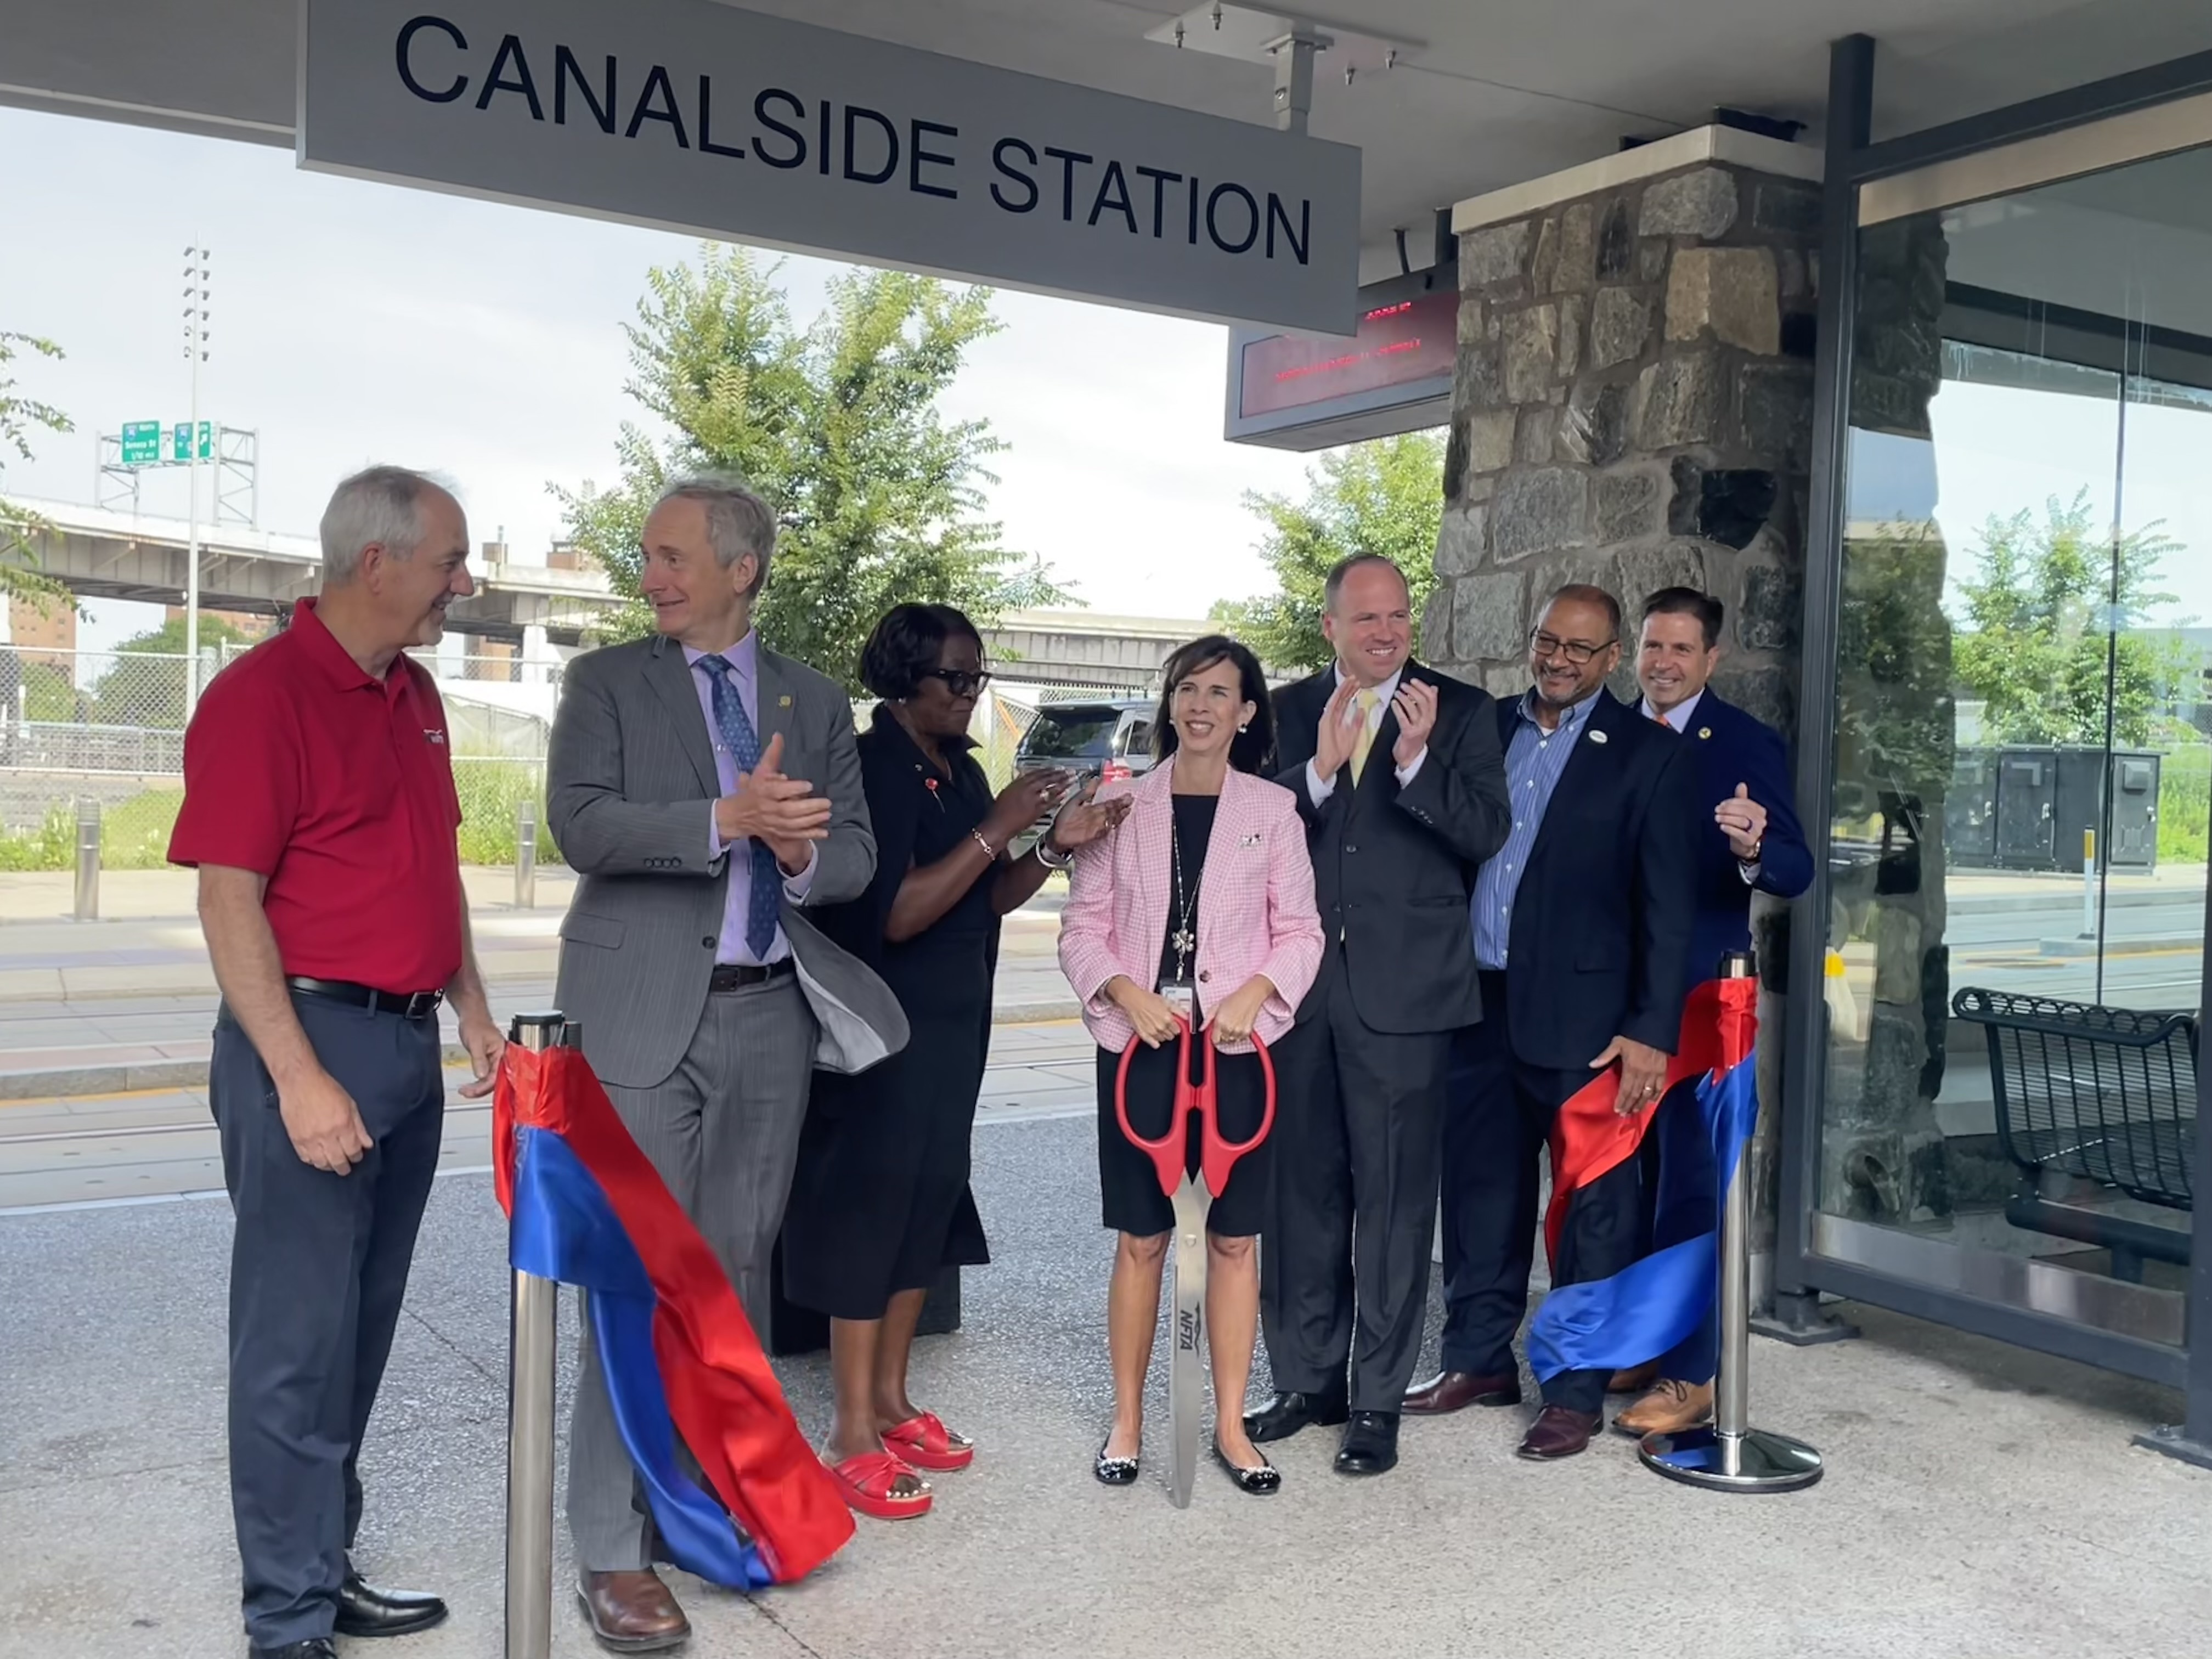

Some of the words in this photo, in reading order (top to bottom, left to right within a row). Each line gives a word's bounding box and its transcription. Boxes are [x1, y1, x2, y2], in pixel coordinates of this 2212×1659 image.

[395, 15, 959, 201] CANALSIDE
[989, 137, 1311, 267] STATION
[1180, 1310, 1193, 1350] NFTA
